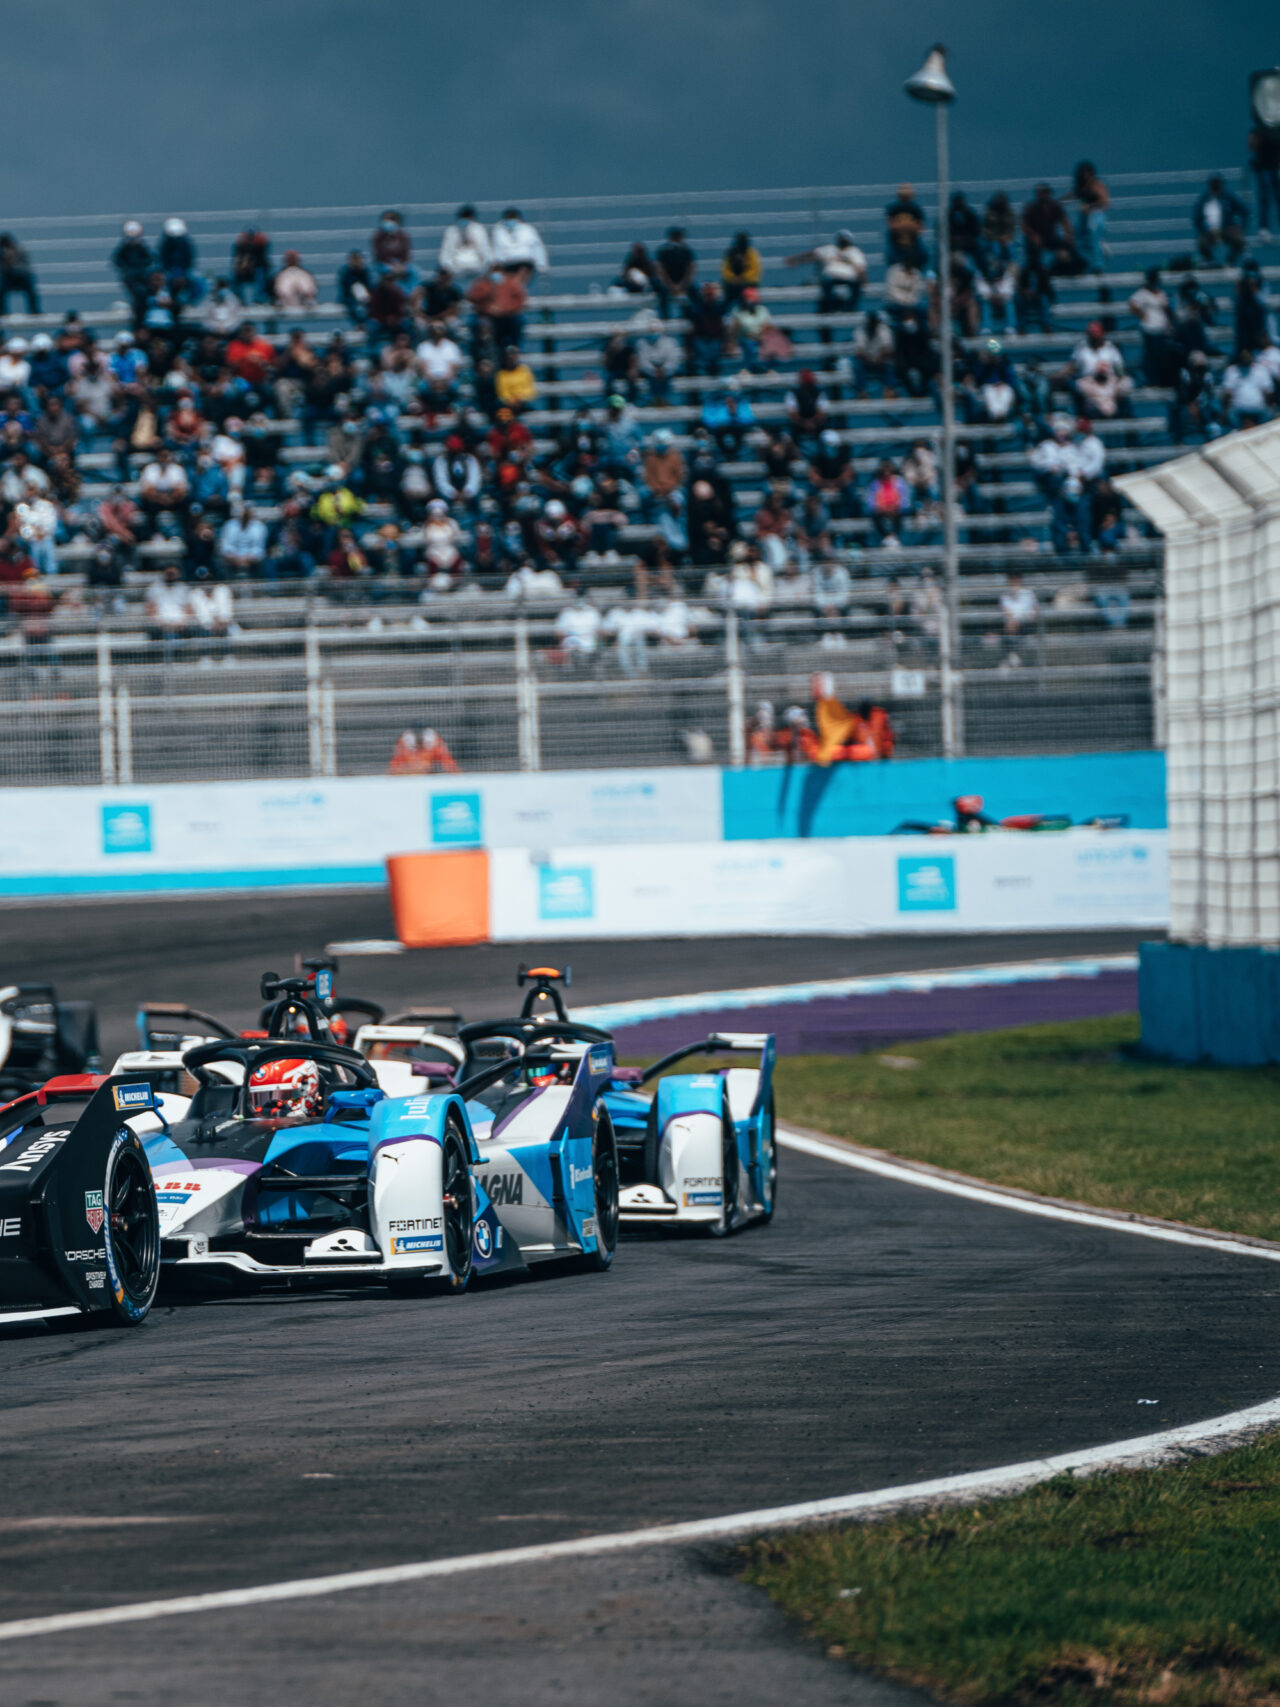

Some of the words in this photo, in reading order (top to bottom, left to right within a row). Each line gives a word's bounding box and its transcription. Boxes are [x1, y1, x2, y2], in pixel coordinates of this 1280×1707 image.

[476, 1173, 523, 1206] AGNA
[86, 1194, 102, 1207] TAG
[406, 1239, 442, 1250] MICHELIN
